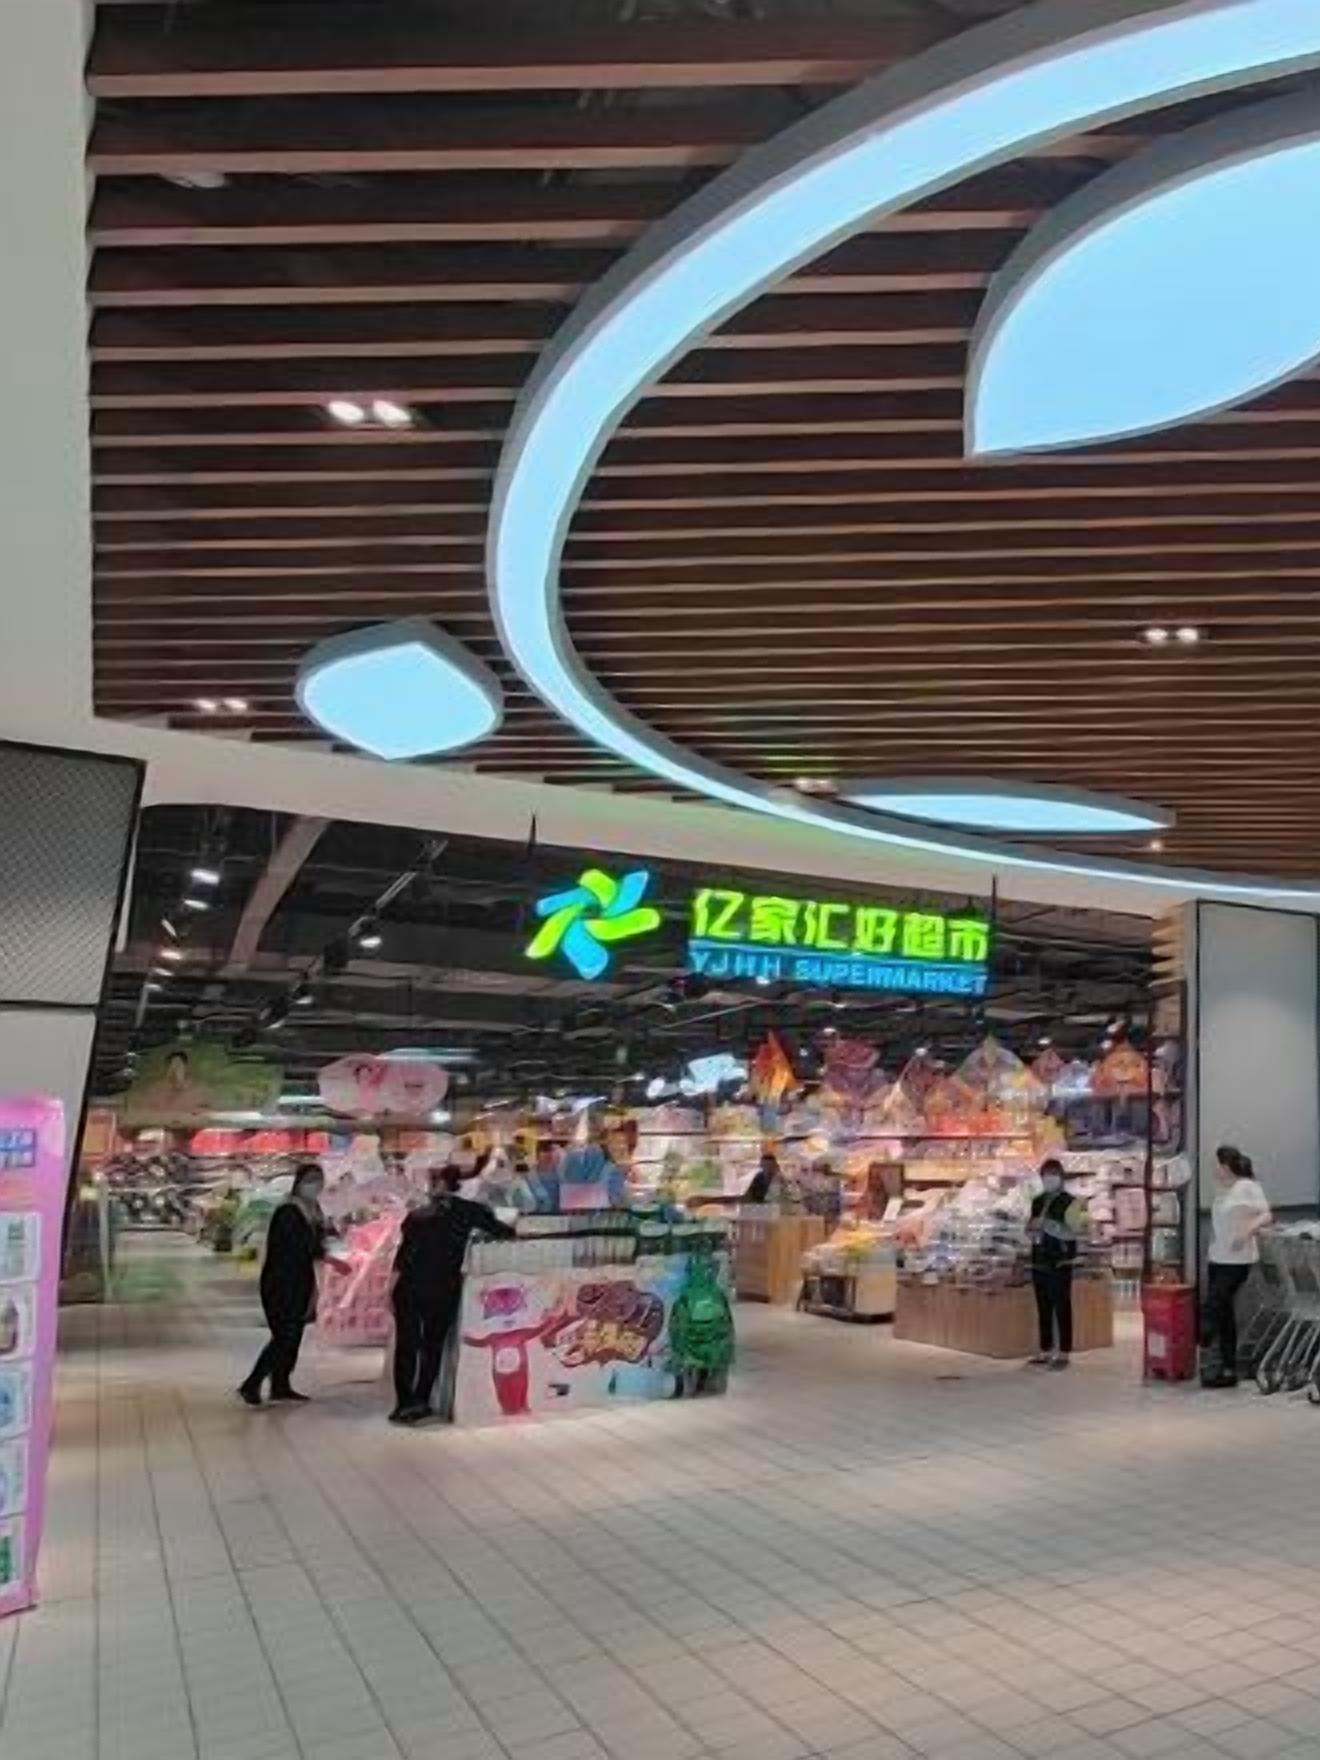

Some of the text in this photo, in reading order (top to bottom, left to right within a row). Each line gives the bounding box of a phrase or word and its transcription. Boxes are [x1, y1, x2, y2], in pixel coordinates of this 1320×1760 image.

[693, 888, 989, 961] 亿家汇好超市
[796, 959, 988, 994] SUPERMARKET
